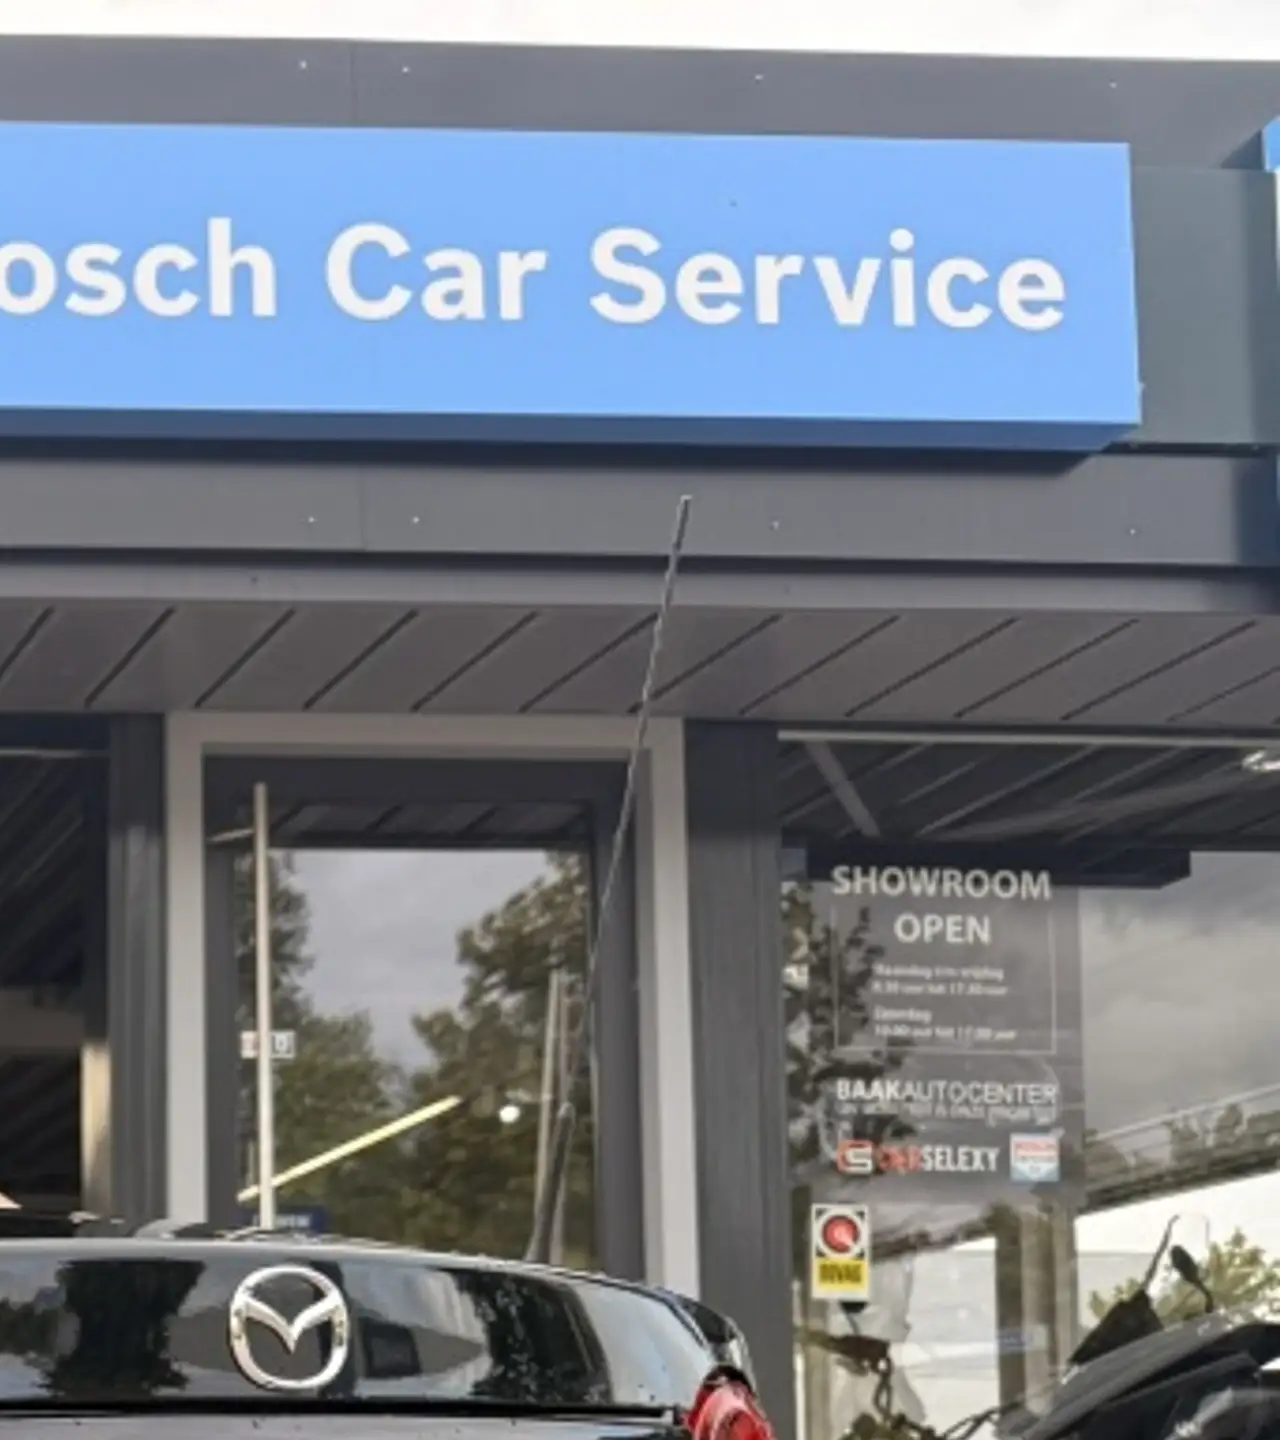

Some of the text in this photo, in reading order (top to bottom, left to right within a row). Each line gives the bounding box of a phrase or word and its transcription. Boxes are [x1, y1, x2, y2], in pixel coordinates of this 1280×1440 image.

[324, 222, 547, 321] Car
[588, 226, 1068, 331] Service
[831, 864, 1053, 901] SHOWROOM
[893, 912, 992, 945] OPEN
